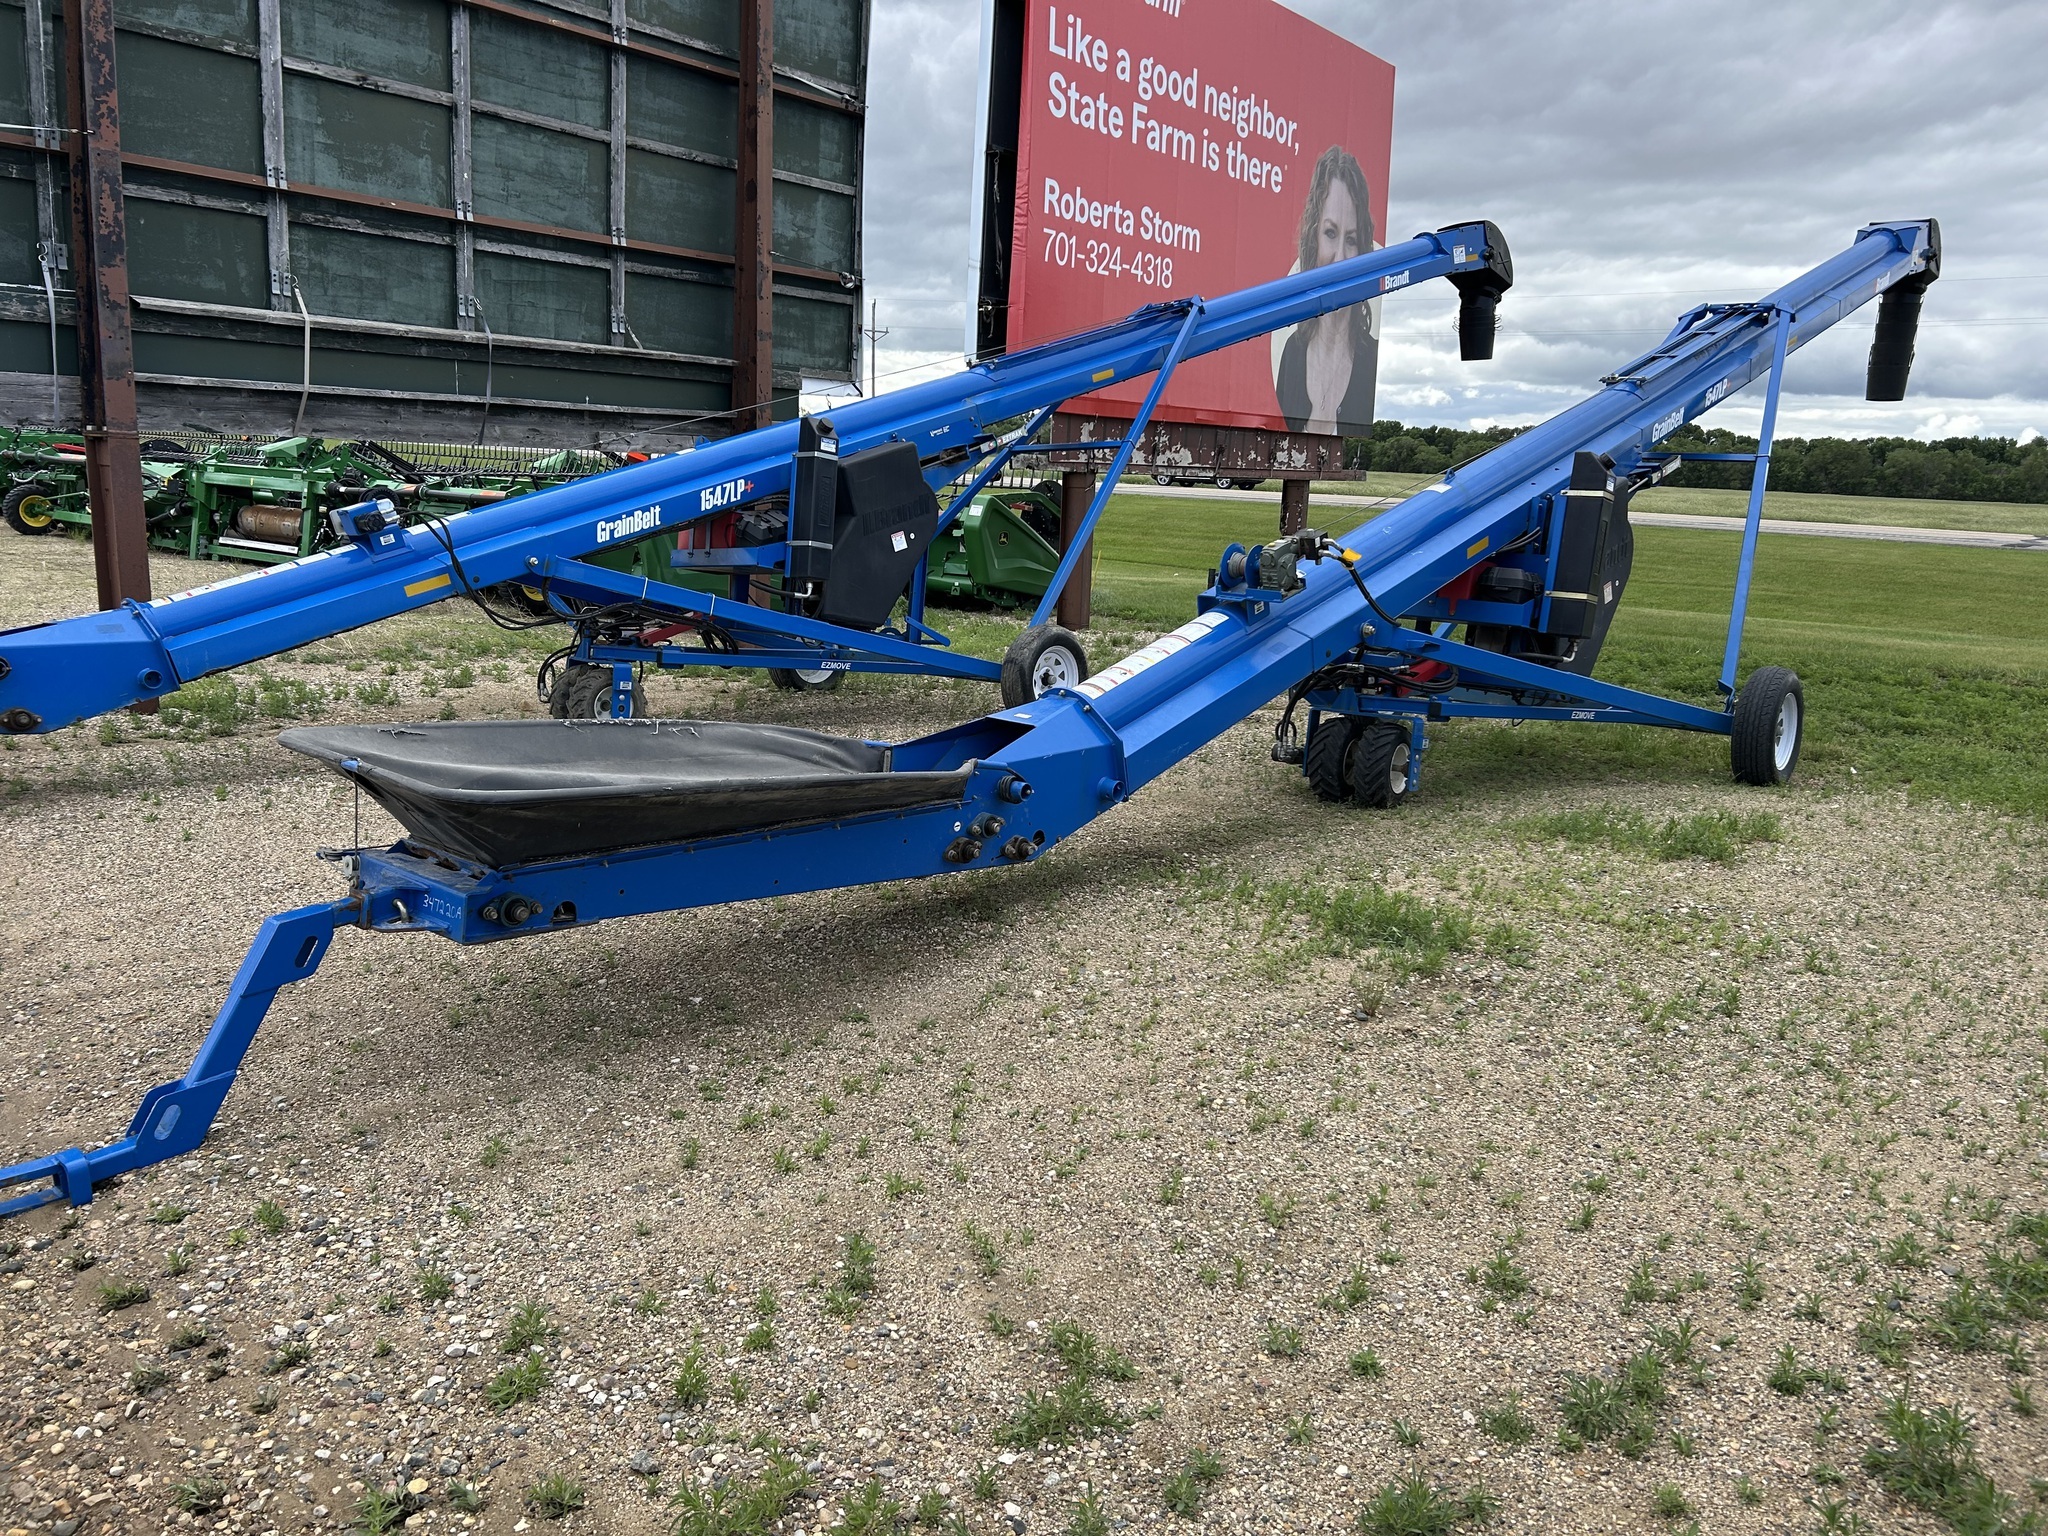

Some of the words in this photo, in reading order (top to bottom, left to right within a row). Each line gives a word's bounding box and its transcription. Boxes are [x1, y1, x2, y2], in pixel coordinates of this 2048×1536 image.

[1049, 6, 1109, 73] Like
[1116, 48, 1131, 83] a
[1138, 57, 1198, 108] good
[1203, 85, 1300, 156] neighbor,
[1048, 71, 1124, 138] State
[1131, 101, 1195, 164] Farm
[1202, 129, 1220, 172] is
[1044, 178, 1135, 237] Roberta
[1140, 206, 1201, 253] Storm
[1043, 227, 1173, 289] 701-324-4318
[1384, 269, 1410, 291] Brandt
[1652, 406, 1685, 443] GrainBelt
[596, 504, 661, 544] GrainBelt
[820, 661, 852, 670] EZMOVE
[1571, 711, 1596, 720] EZMOVE
